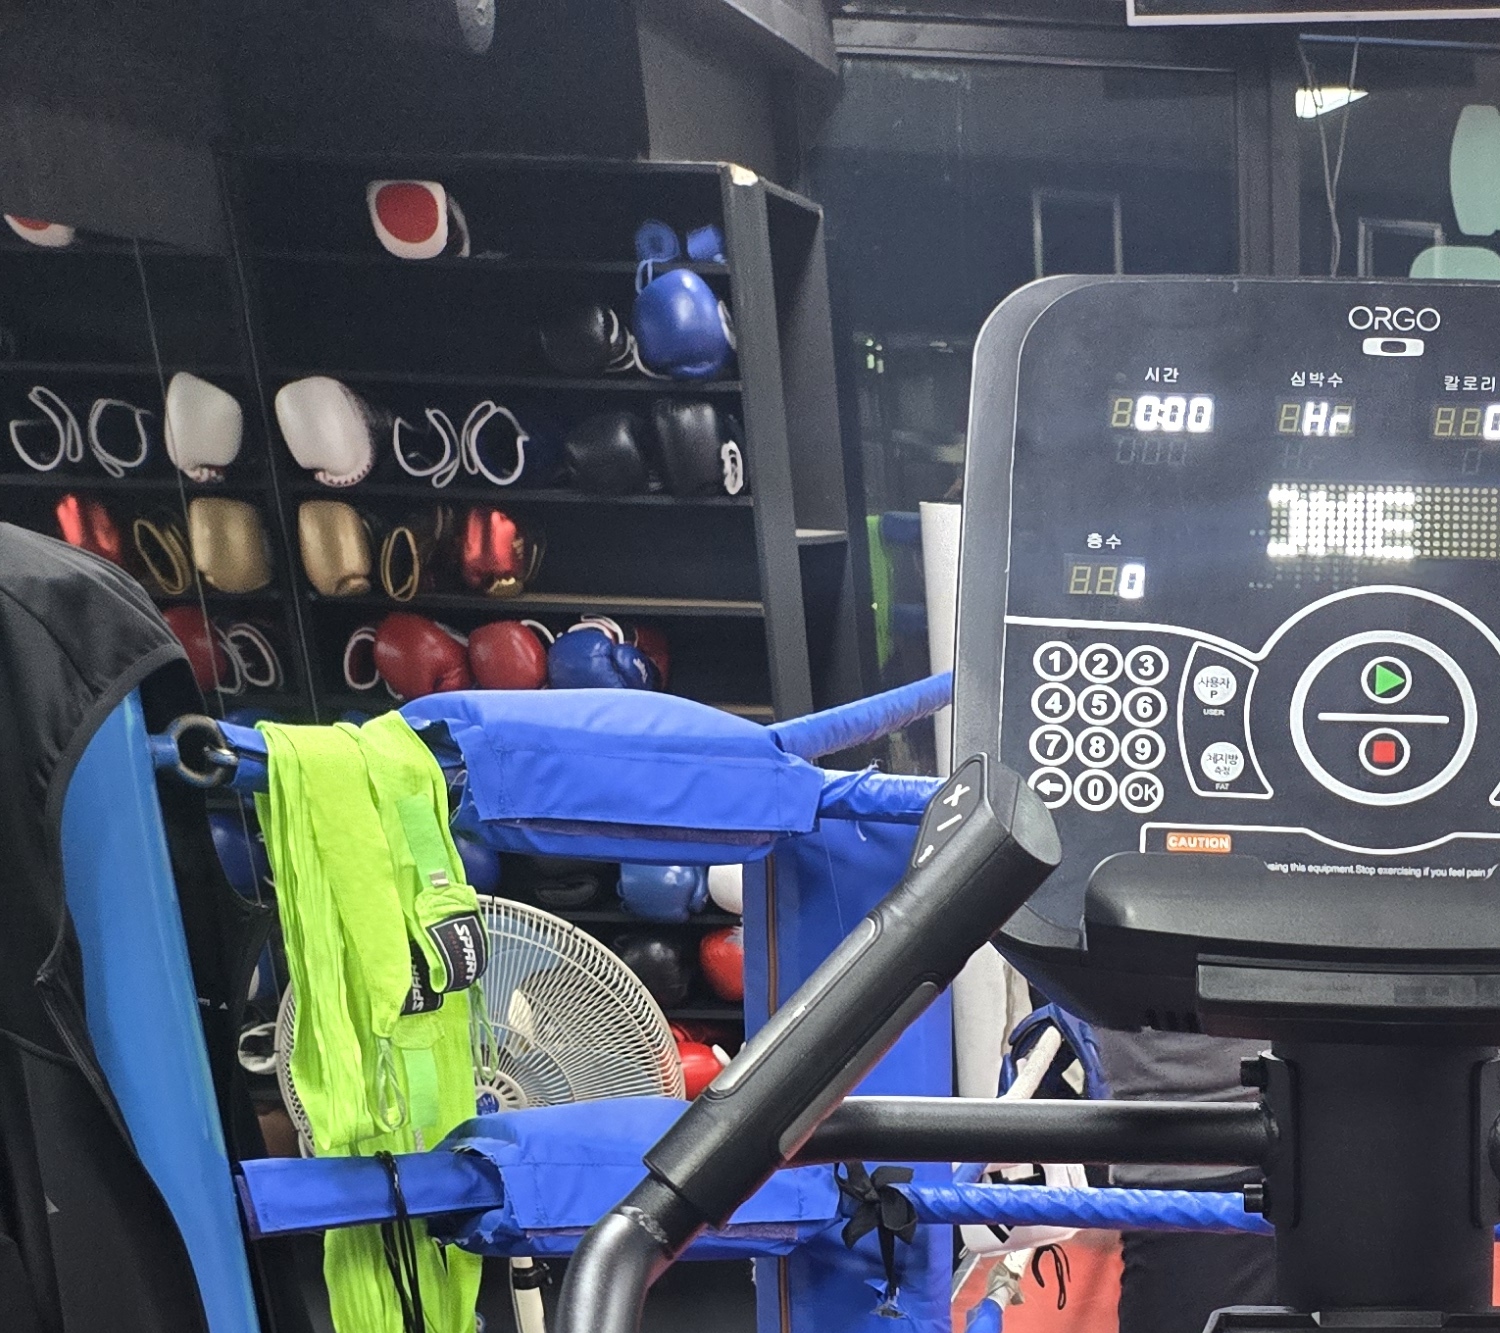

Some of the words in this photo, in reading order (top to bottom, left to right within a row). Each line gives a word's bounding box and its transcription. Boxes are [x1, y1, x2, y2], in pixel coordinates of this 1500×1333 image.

[1348, 306, 1441, 332] ORGO
[1144, 367, 1180, 383] 시간
[1290, 371, 1344, 388] 심박수
[1443, 375, 1497, 393] 칼로리
[1086, 532, 1122, 550] 층수
[1049, 651, 1061, 673] 1
[1091, 653, 1109, 676] 2
[1138, 654, 1155, 677] 3
[1198, 676, 1230, 689] 사용자
[1044, 691, 1063, 714] 4
[1090, 693, 1108, 716] 5
[1210, 690, 1218, 699] P
[1136, 695, 1153, 719] 6
[1202, 708, 1226, 717] USER
[1045, 734, 1062, 756] 7
[1089, 735, 1106, 759] 8
[1134, 737, 1152, 761] 9
[1087, 778, 1104, 802] 0
[1127, 782, 1158, 802] OK
[1215, 782, 1230, 791] FAT
[1168, 835, 1229, 850] CAUTION
[1289, 862, 1307, 873] this
[1355, 864, 1376, 876] Stop
[1377, 865, 1422, 879] exercising
[1430, 868, 1448, 879] you
[1448, 867, 1466, 877] feel
[1466, 868, 1486, 880] pain
